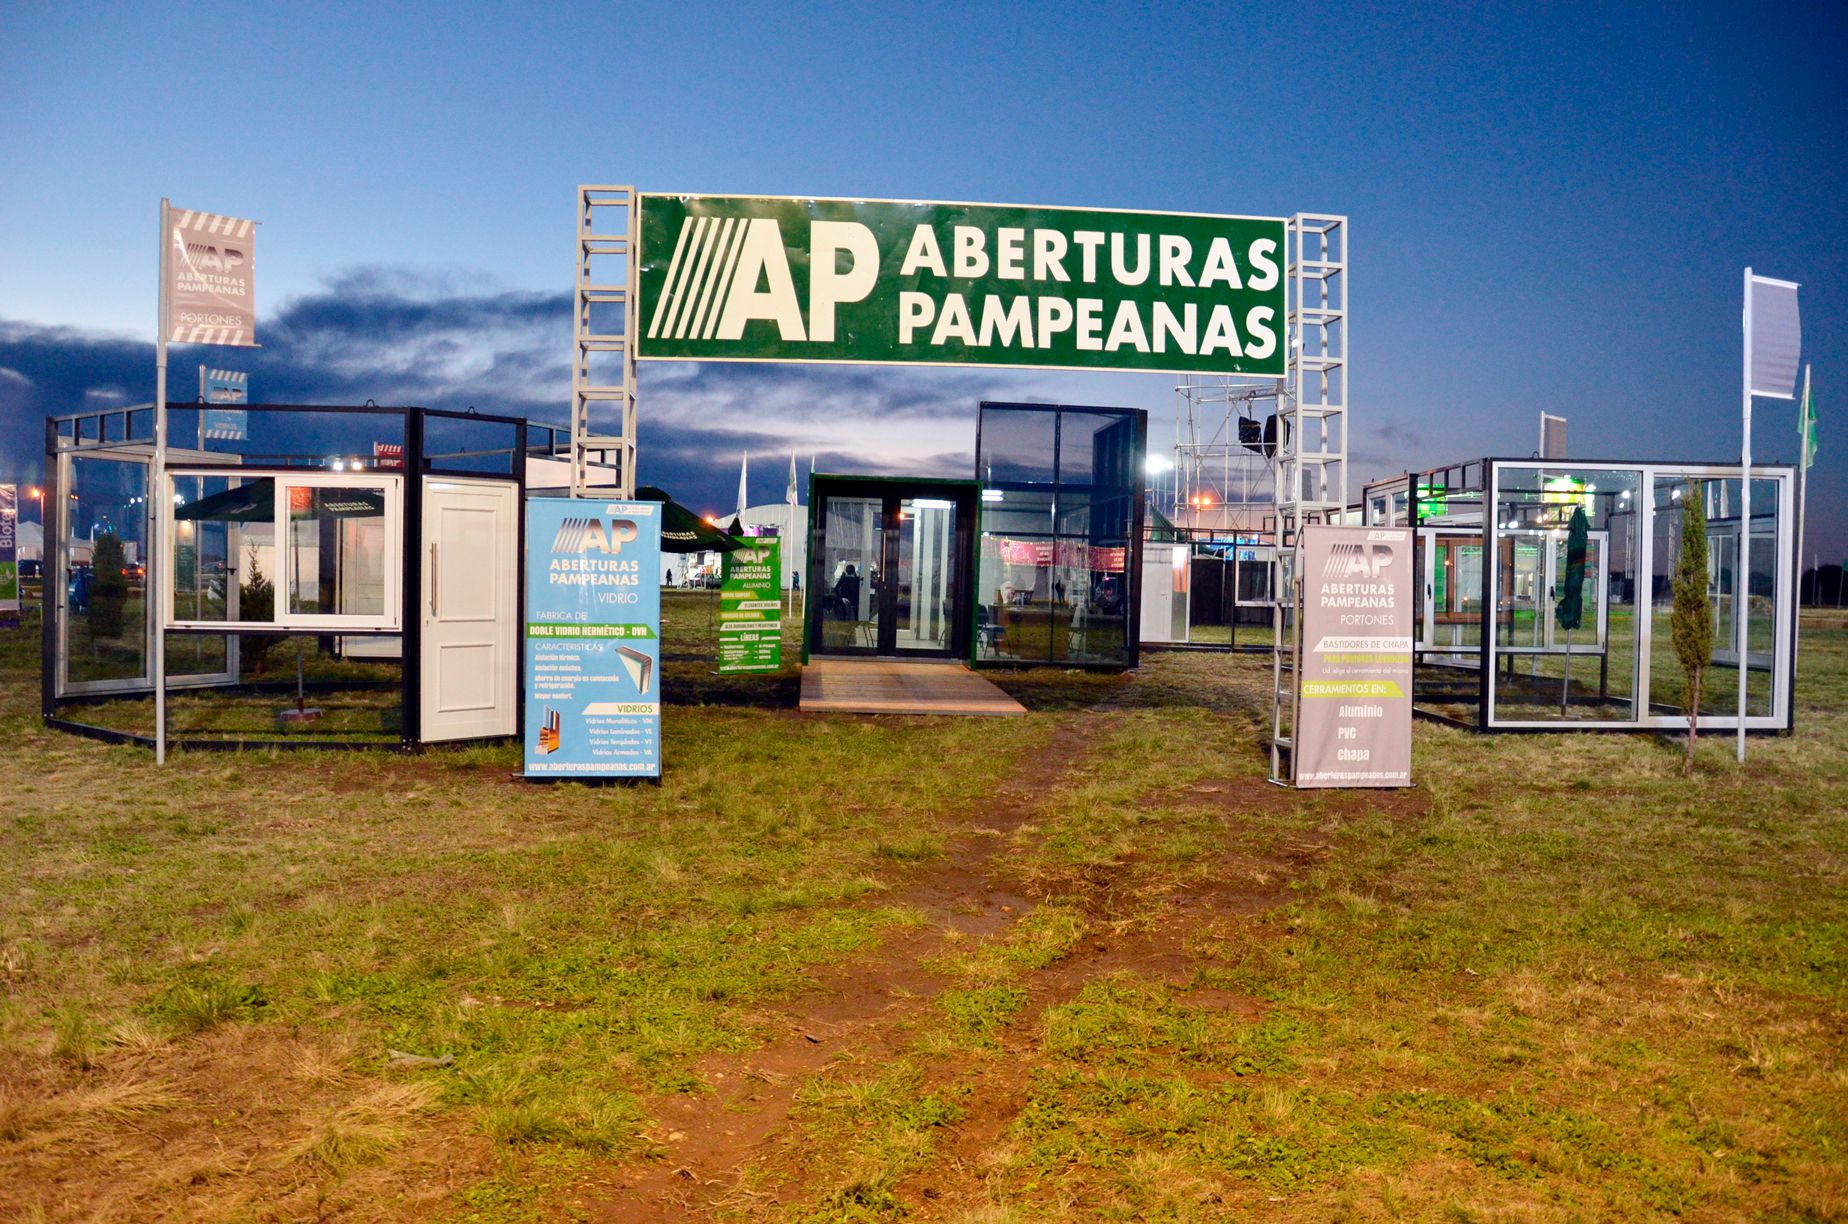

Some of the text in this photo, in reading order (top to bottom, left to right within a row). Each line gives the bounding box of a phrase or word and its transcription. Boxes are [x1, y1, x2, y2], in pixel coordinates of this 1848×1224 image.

[199, 244, 244, 274] AP
[900, 223, 1278, 292] ABERTURAS
[177, 272, 246, 287] ABERTURAS
[715, 218, 880, 342] AP
[177, 281, 246, 297] PAMPEANAS
[180, 312, 242, 326] PORTONES
[899, 293, 1278, 360] PAMPEANAS
[577, 518, 638, 554] AP
[549, 559, 639, 572] ABERTURAS
[1344, 544, 1394, 578] AP
[730, 565, 771, 573] ABERTURAS
[549, 573, 639, 586] PAMPEANAS
[730, 572, 771, 580] PAMPEANAS
[1321, 584, 1395, 595] ABERTURAS
[597, 592, 639, 604] VIDRIO
[1321, 597, 1395, 609] PAMPEANAS
[575, 611, 588, 620] DE
[1340, 614, 1394, 625] PORTONES
[529, 625, 554, 635] DOBLE
[555, 625, 581, 636] VIDRIO
[1323, 640, 1409, 649] BASTIDORES DE CHAPA
[1304, 684, 1387, 695] CERRAMIENTOS EN:
[617, 704, 653, 713] VIDRIOS
[1338, 705, 1384, 718] Aluminio
[1338, 727, 1357, 739] PVC
